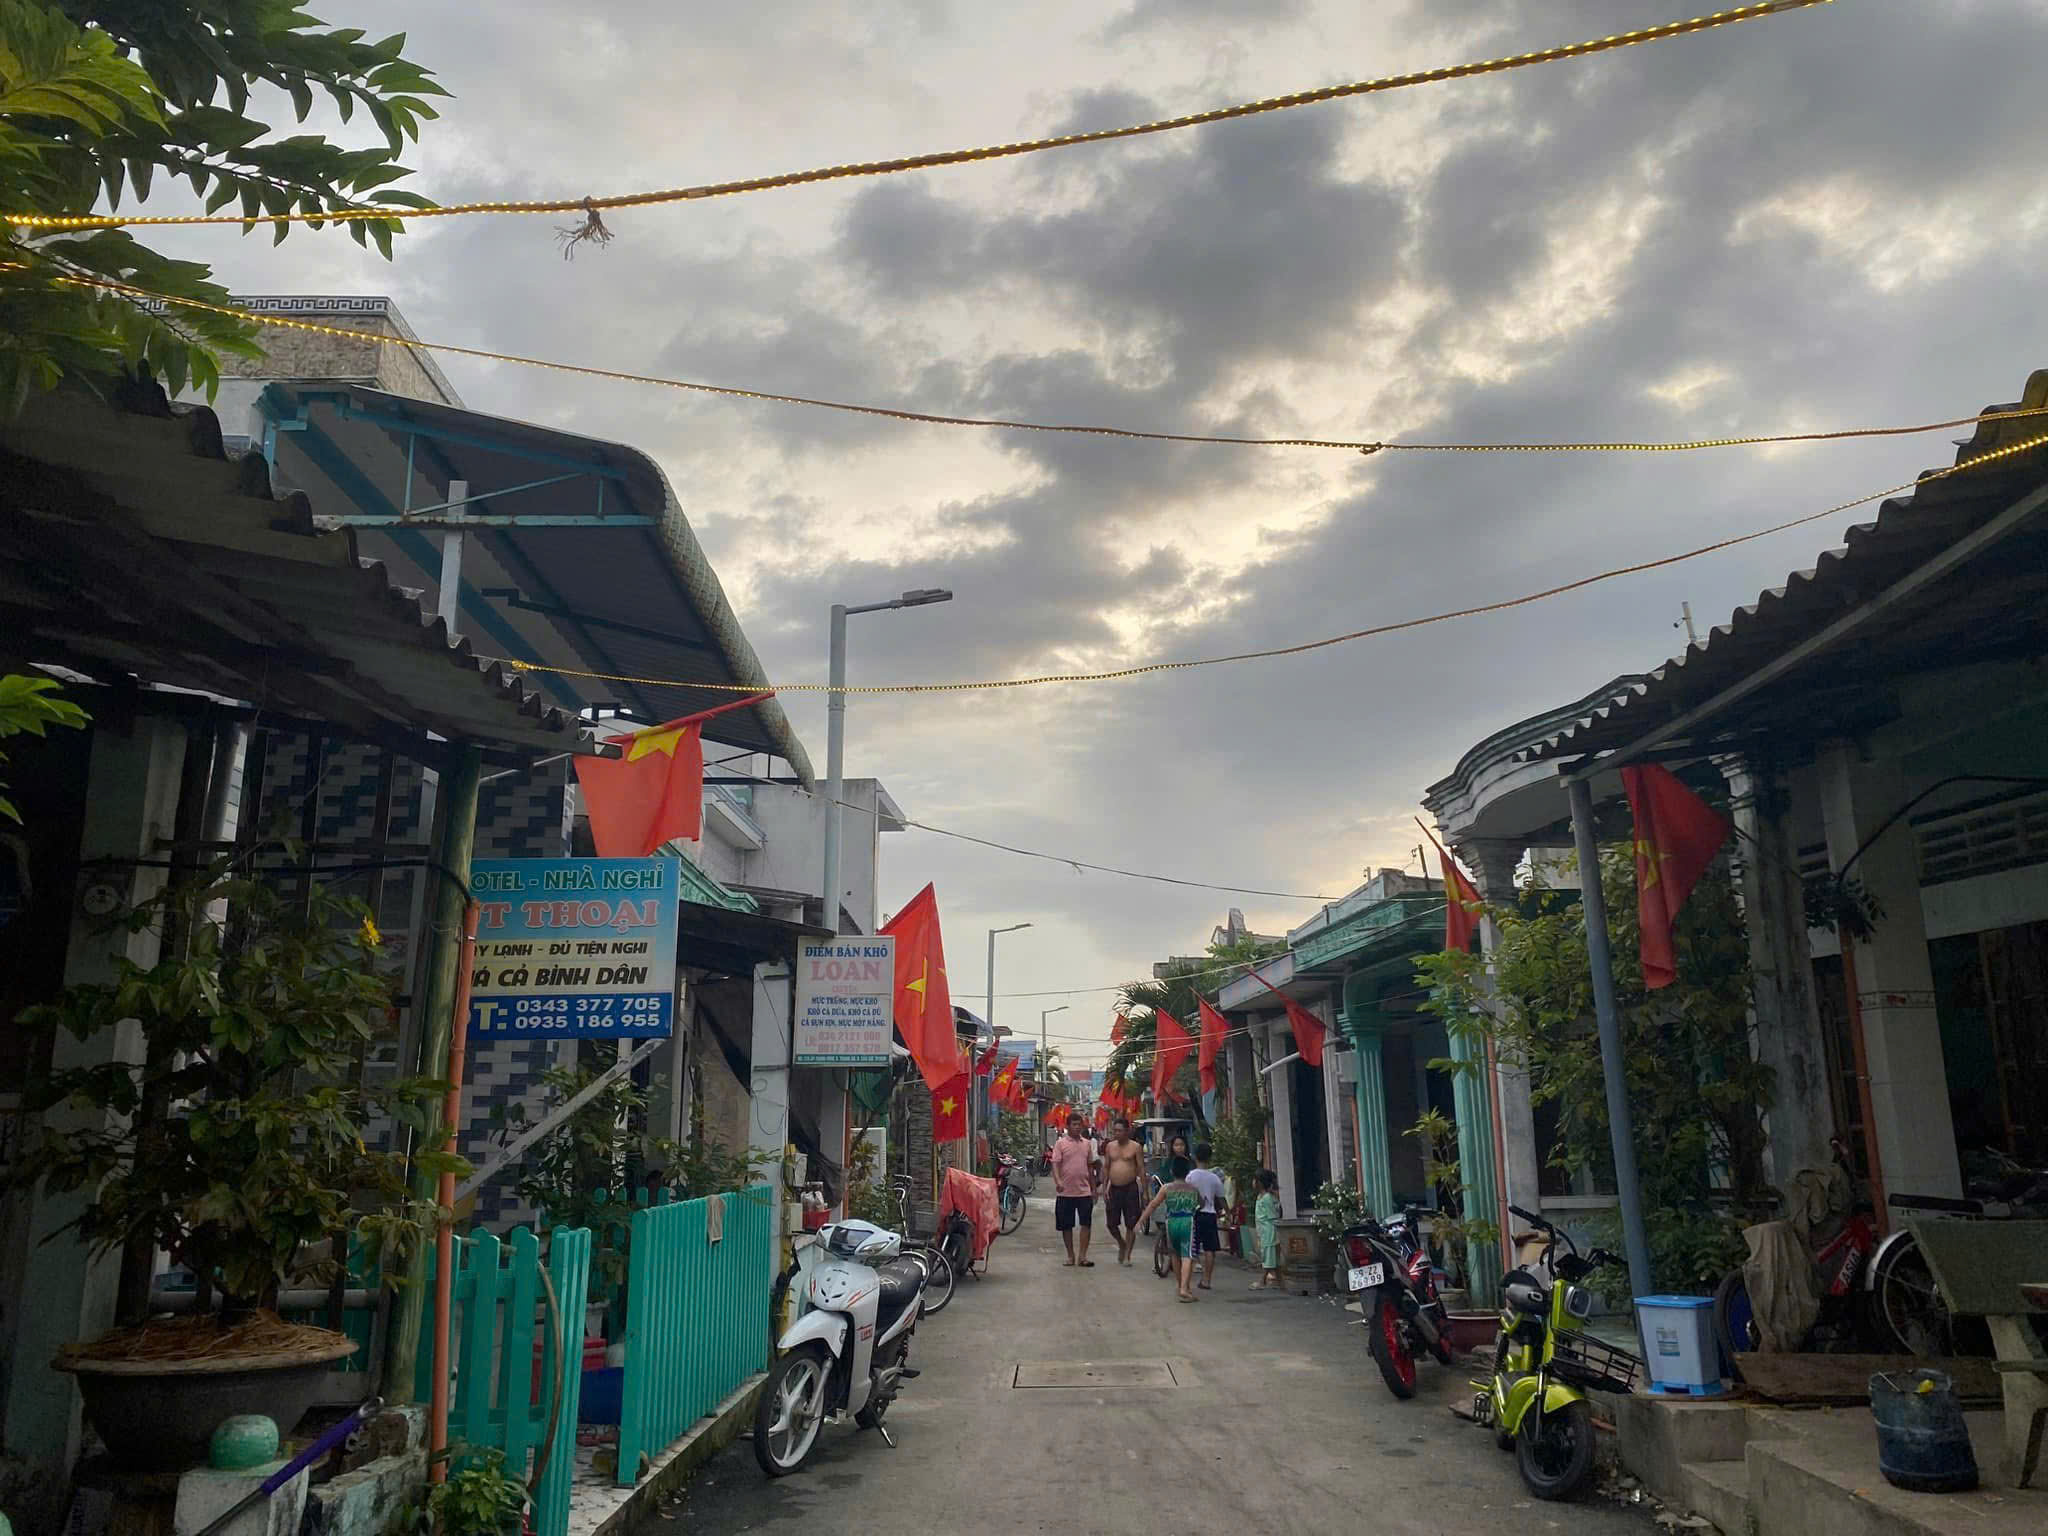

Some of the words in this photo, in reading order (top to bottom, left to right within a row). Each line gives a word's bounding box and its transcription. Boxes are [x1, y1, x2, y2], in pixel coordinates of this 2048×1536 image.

[469, 872, 525, 891] OTEL
[544, 865, 596, 890] NHÀ
[603, 864, 664, 890] NGHỈ
[480, 901, 512, 928] T
[522, 899, 661, 934] THOẠI
[493, 944, 533, 958] LẠNH
[549, 941, 571, 955] ĐỦ
[576, 942, 607, 958] TIỆN
[611, 942, 648, 955] NGHI
[837, 943, 861, 958] BÁN
[864, 944, 888, 958] KHÔ
[498, 963, 529, 986] CẢ
[596, 962, 649, 985] DÂN
[811, 960, 881, 980] LOAN
[473, 1001, 507, 1031] T:
[516, 999, 568, 1013] 0343
[576, 999, 615, 1012] 377
[622, 998, 661, 1011] 705
[515, 1015, 568, 1029] 0935
[576, 1015, 614, 1028] 186
[621, 1014, 660, 1027] 955
